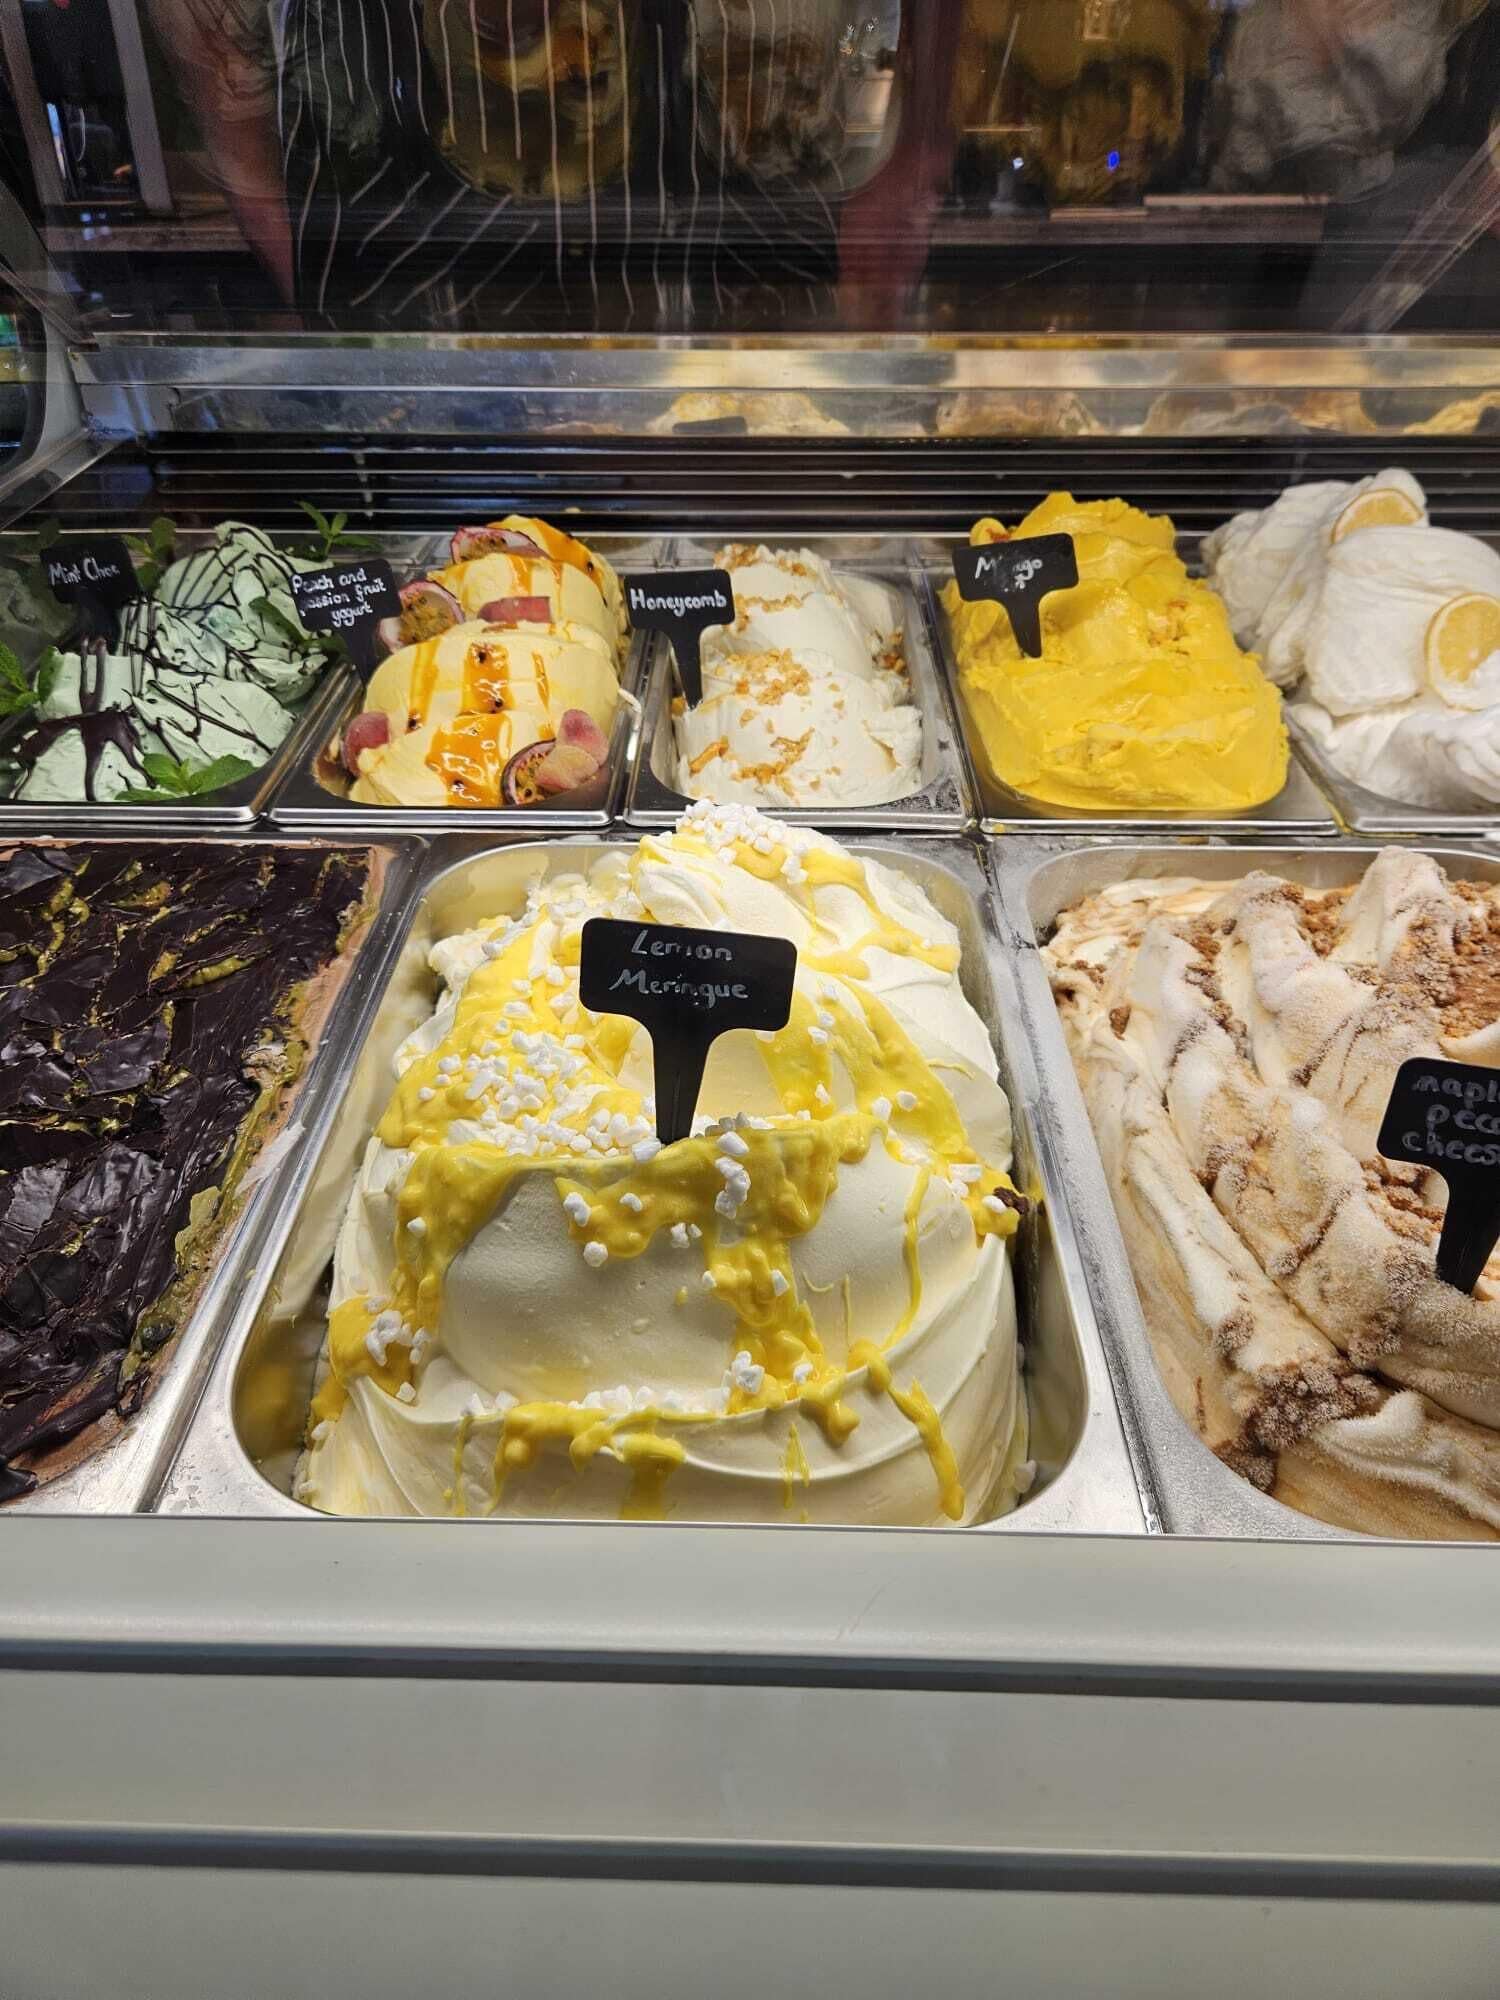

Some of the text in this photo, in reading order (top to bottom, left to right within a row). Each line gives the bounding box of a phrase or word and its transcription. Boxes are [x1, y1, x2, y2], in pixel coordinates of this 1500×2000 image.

[339, 567, 367, 586] and
[975, 554, 1043, 581] Mngo
[300, 577, 387, 617] assion fruit
[630, 588, 727, 617] Honeycomb
[330, 601, 374, 628] yogurt
[631, 929, 732, 961] Lemon
[608, 968, 749, 1009] Meringue
[1412, 1075, 1500, 1109] mapl
